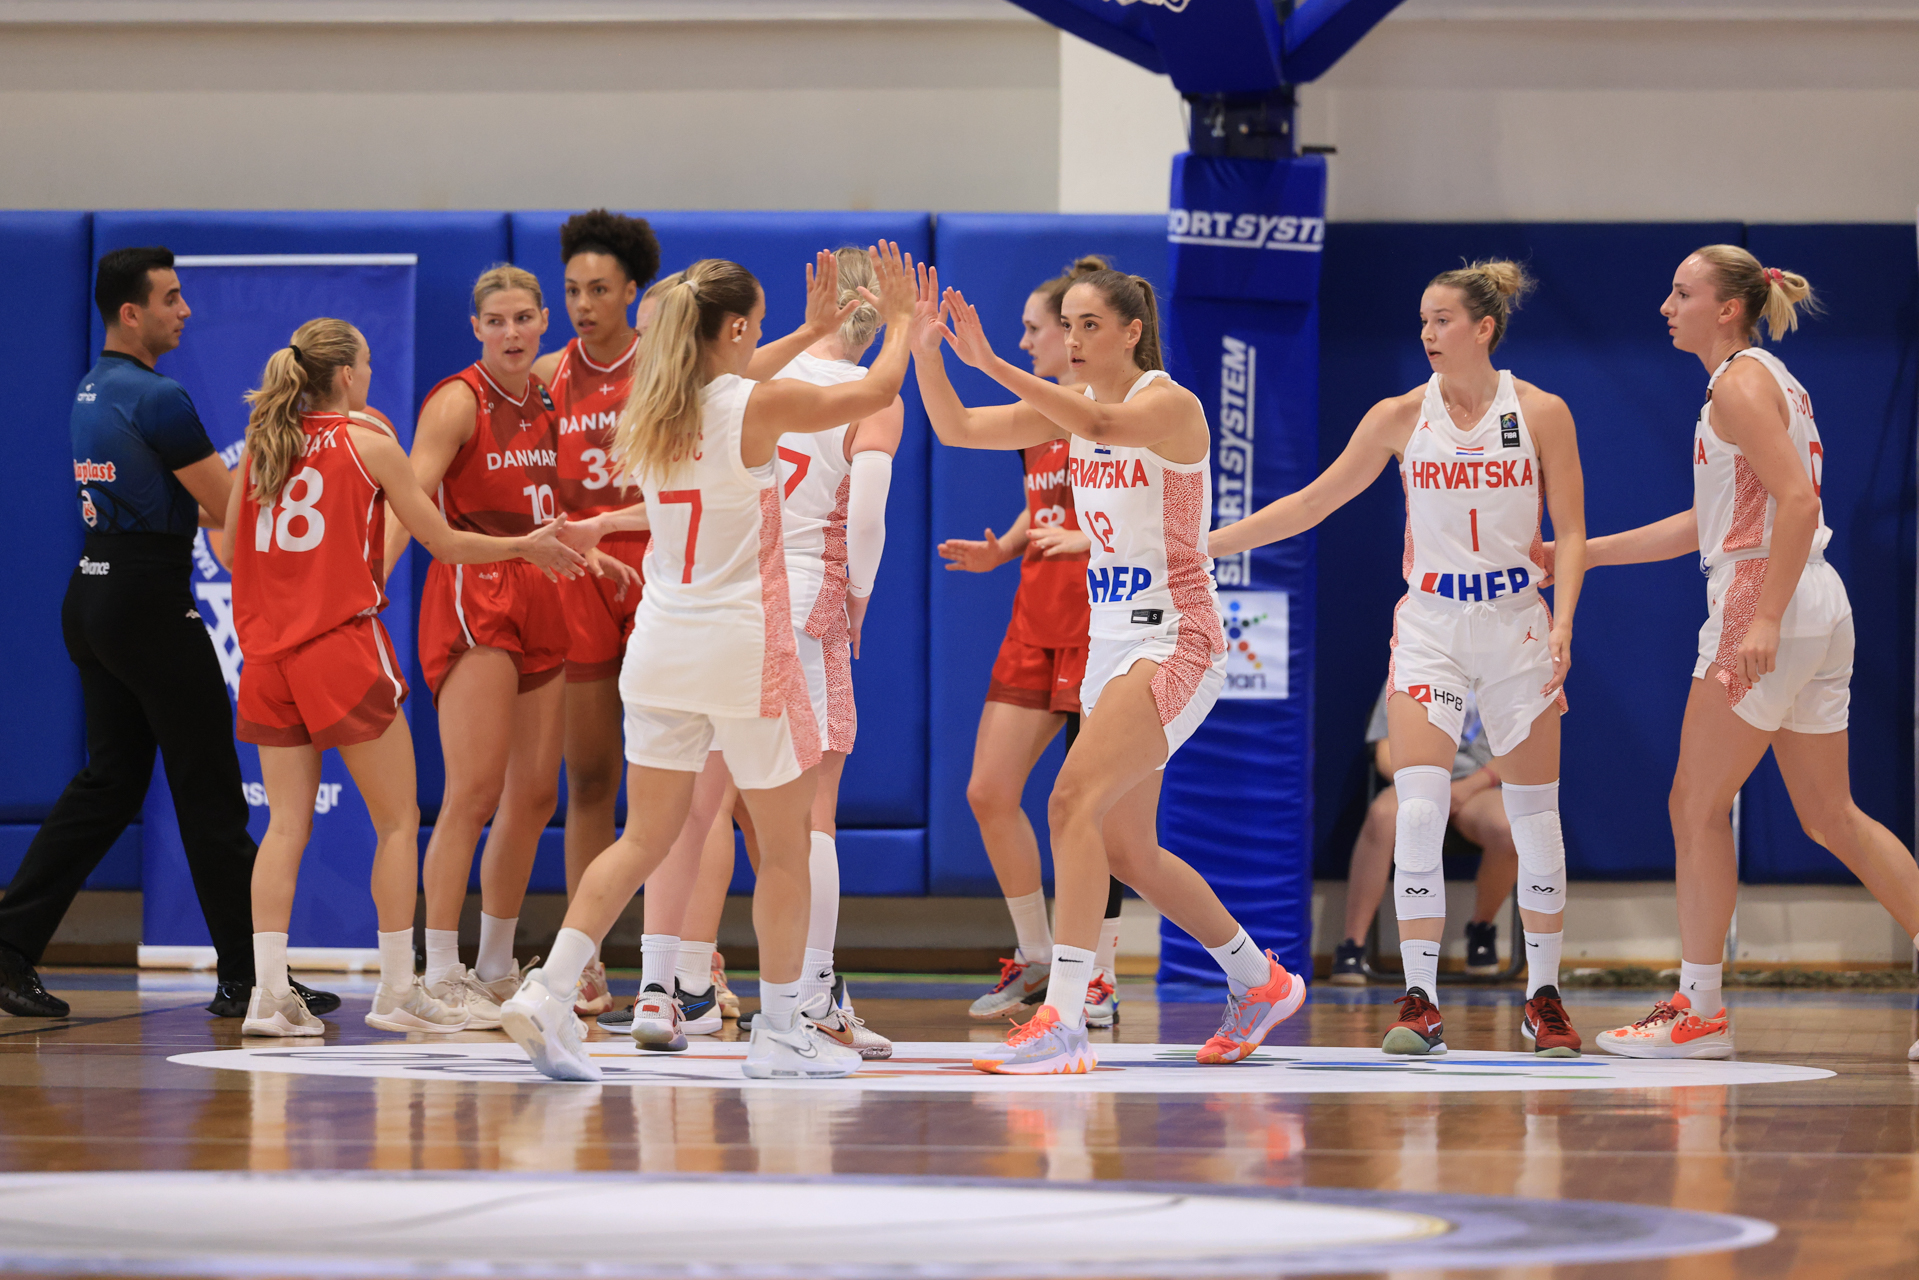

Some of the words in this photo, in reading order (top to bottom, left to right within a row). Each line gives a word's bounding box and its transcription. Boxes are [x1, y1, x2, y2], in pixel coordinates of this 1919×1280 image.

[1168, 208, 1233, 237] ORT
[1219, 334, 1250, 475] SYSTEM
[1503, 431, 1518, 440] FIBA
[1412, 458, 1534, 490] HRVATSKA
[252, 466, 326, 554] 18
[523, 483, 555, 525] 10
[658, 488, 703, 584] 7
[1468, 508, 1480, 552] 1
[1087, 566, 1152, 603] HEP
[1433, 688, 1463, 712] HPB
